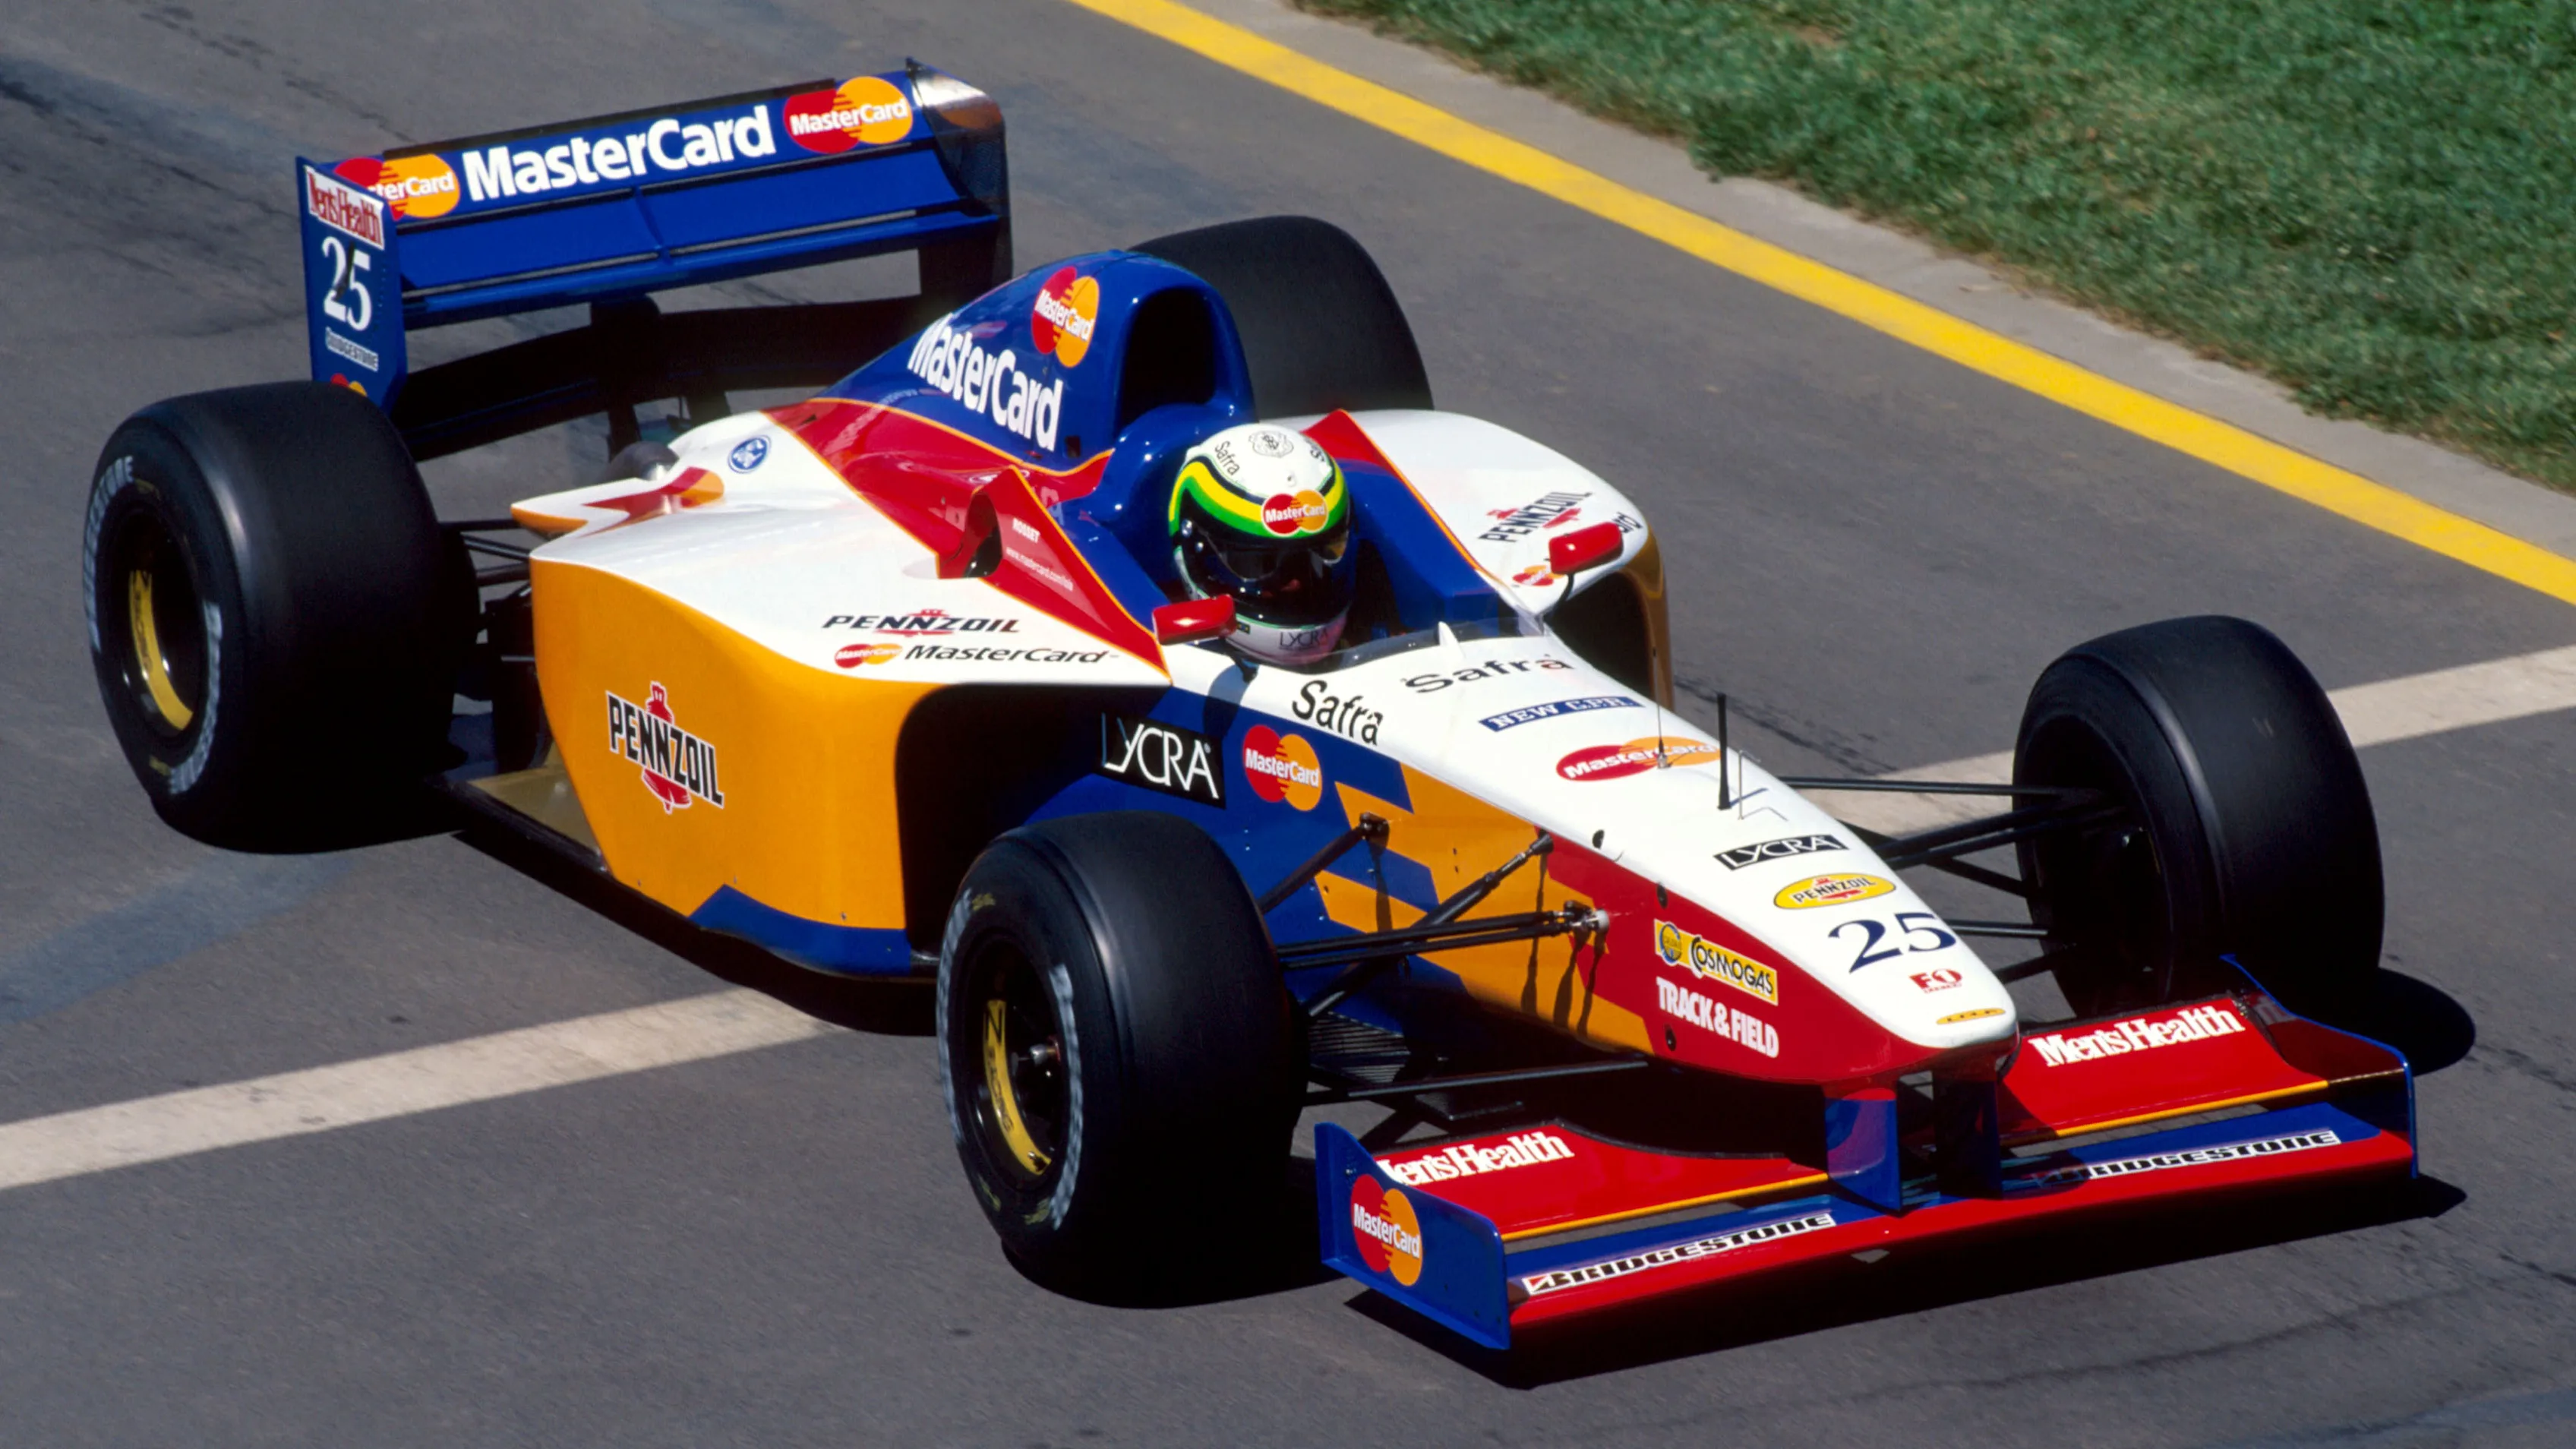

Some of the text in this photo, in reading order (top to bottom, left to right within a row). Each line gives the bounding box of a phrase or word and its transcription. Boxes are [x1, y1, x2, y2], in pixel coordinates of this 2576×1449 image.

[790, 87, 909, 137] MasterCard
[463, 105, 775, 201] MasterCard
[322, 236, 371, 330] 25
[1034, 289, 1094, 342] MasterCard
[907, 312, 1063, 452] MasterCard
[1214, 440, 1240, 476] Safra
[1265, 504, 1326, 523] MasterCard
[1477, 491, 1593, 542] PENNZOIL
[822, 615, 1020, 633] PENNZOIL
[904, 645, 1110, 664] MasterCard
[1405, 655, 1575, 693] Safra
[1292, 679, 1383, 747] Safra
[1488, 704, 1559, 729] NEW
[608, 692, 724, 808] PENNZOIL
[1245, 747, 1320, 788] MasterCard
[1720, 836, 1843, 868] LYCRA
[1792, 877, 1877, 904] PENNZOIL
[1690, 936, 1773, 995] COSMOGAS
[1827, 912, 1956, 974] 25
[1908, 968, 1962, 990] F1
[1353, 1202, 1421, 1259] MasterCard
[1523, 1213, 1836, 1295] BRIDGESTONE
